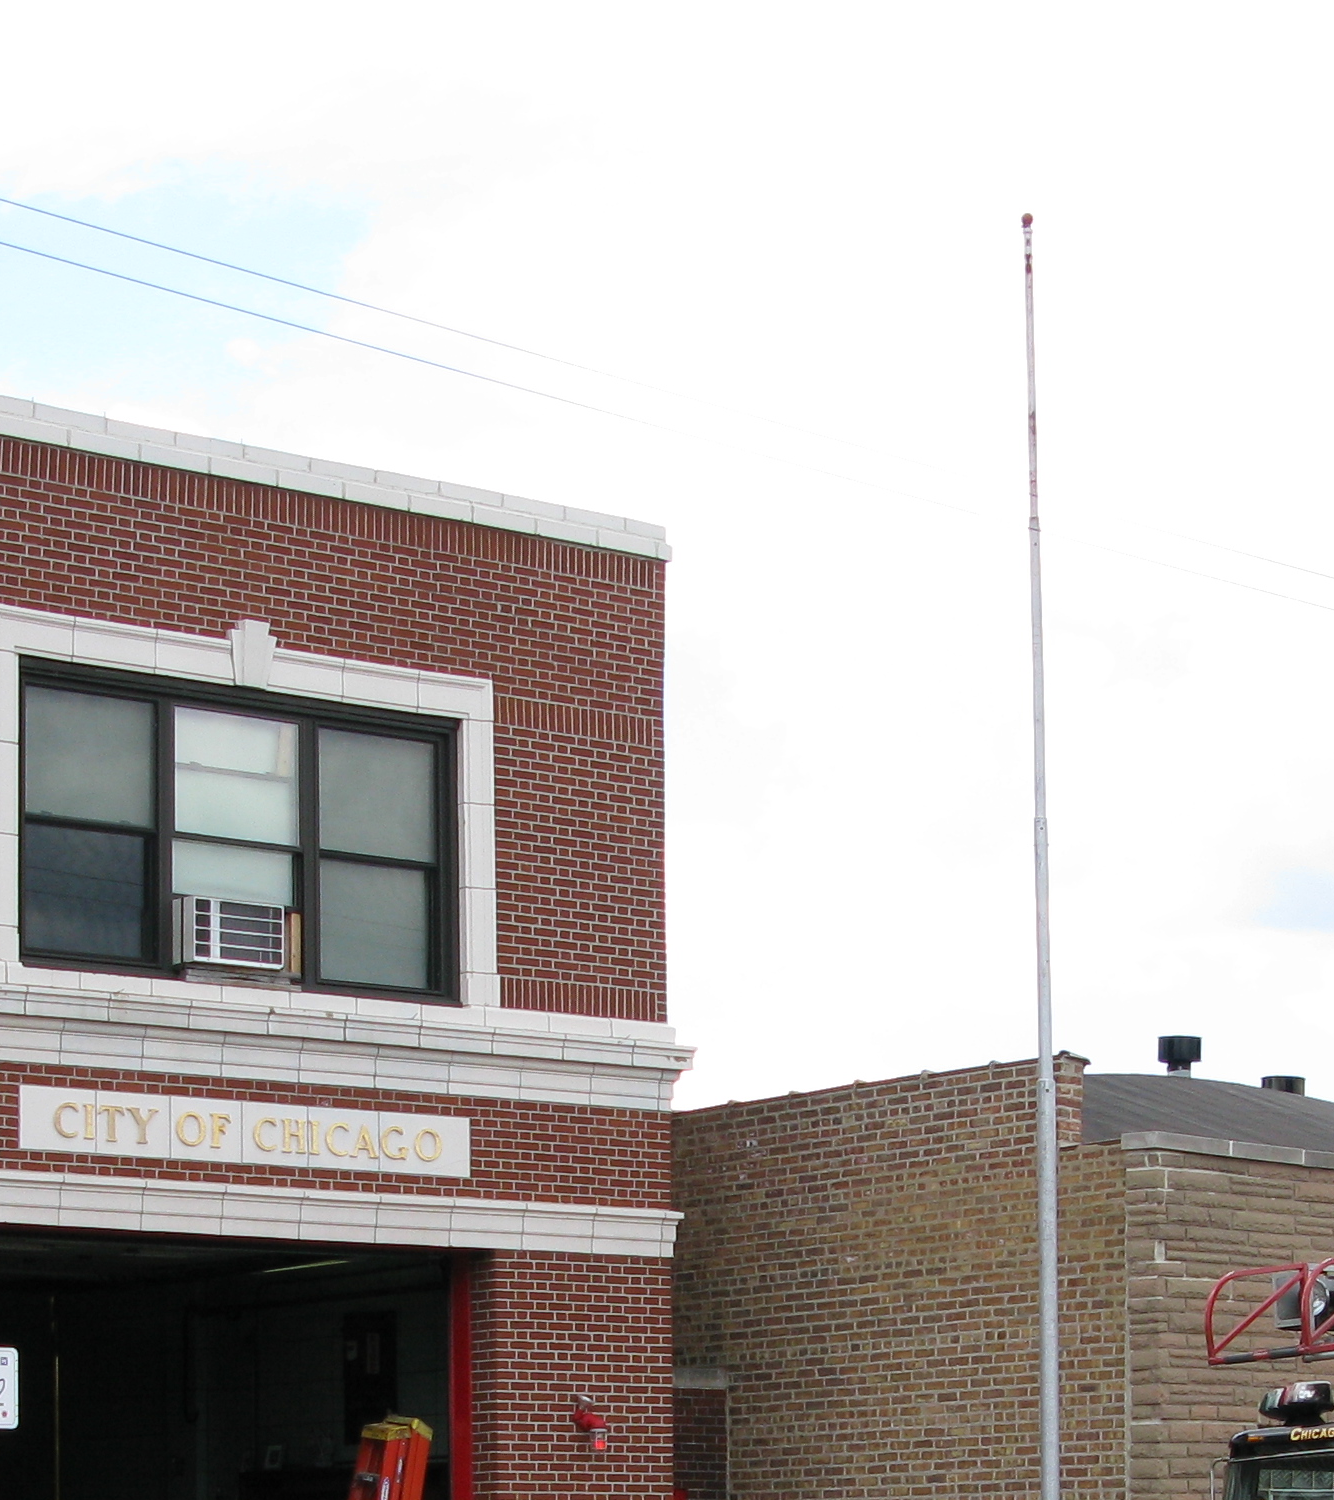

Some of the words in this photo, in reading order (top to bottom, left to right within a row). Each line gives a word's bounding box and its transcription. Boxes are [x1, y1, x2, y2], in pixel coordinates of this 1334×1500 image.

[53, 1101, 158, 1145] CITY
[176, 1111, 232, 1149] OF
[253, 1117, 444, 1162] CHICAGO
